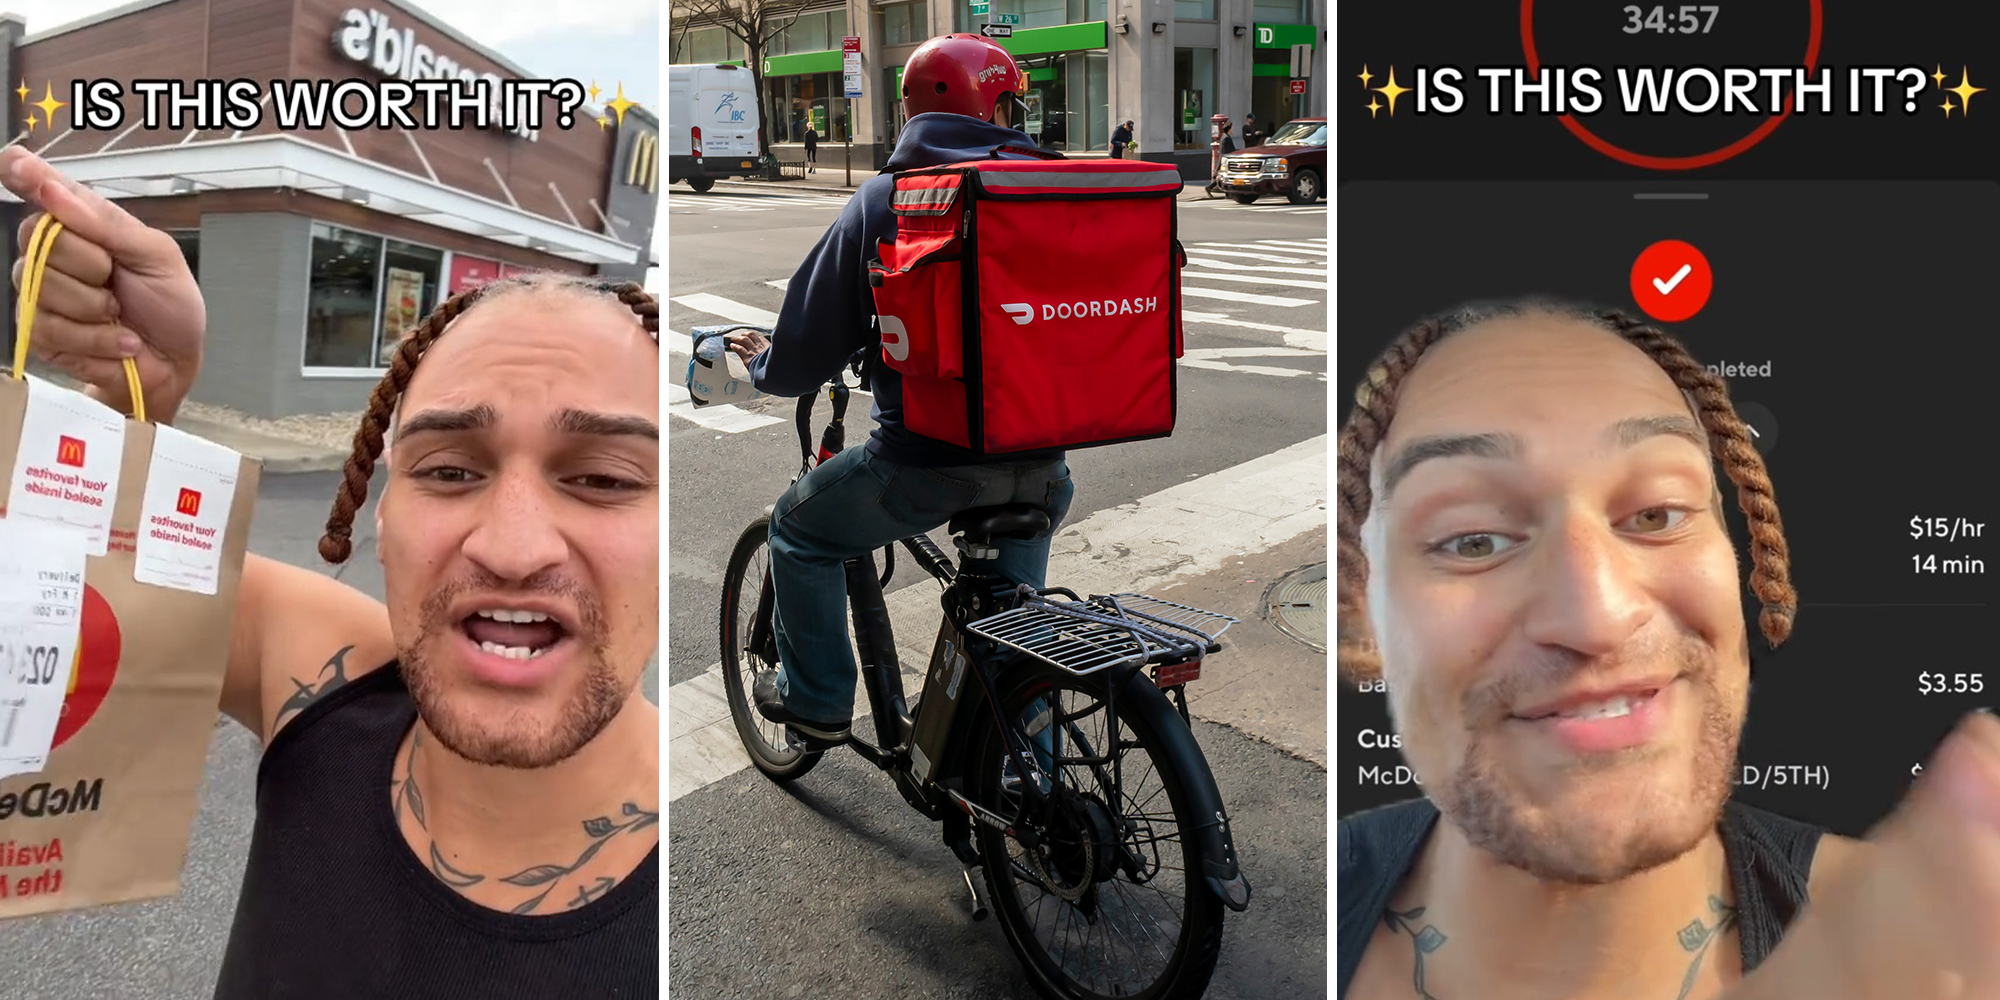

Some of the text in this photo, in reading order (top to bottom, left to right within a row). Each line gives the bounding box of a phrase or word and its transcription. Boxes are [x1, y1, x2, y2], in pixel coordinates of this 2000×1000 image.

[1622, 6, 1719, 34] 34:57
[1258, 27, 1273, 44] TD
[731, 110, 746, 121] IBC
[1042, 296, 1157, 321] DOORDASH
[1706, 360, 1771, 378] pleted
[1909, 515, 1985, 542] $15/hr
[1912, 554, 1985, 574] 14 min
[1358, 678, 1387, 693] Ba
[1918, 670, 1984, 696] $3.55
[1357, 728, 1403, 749] Cus
[1358, 765, 1830, 791] McDo D/5TH)
